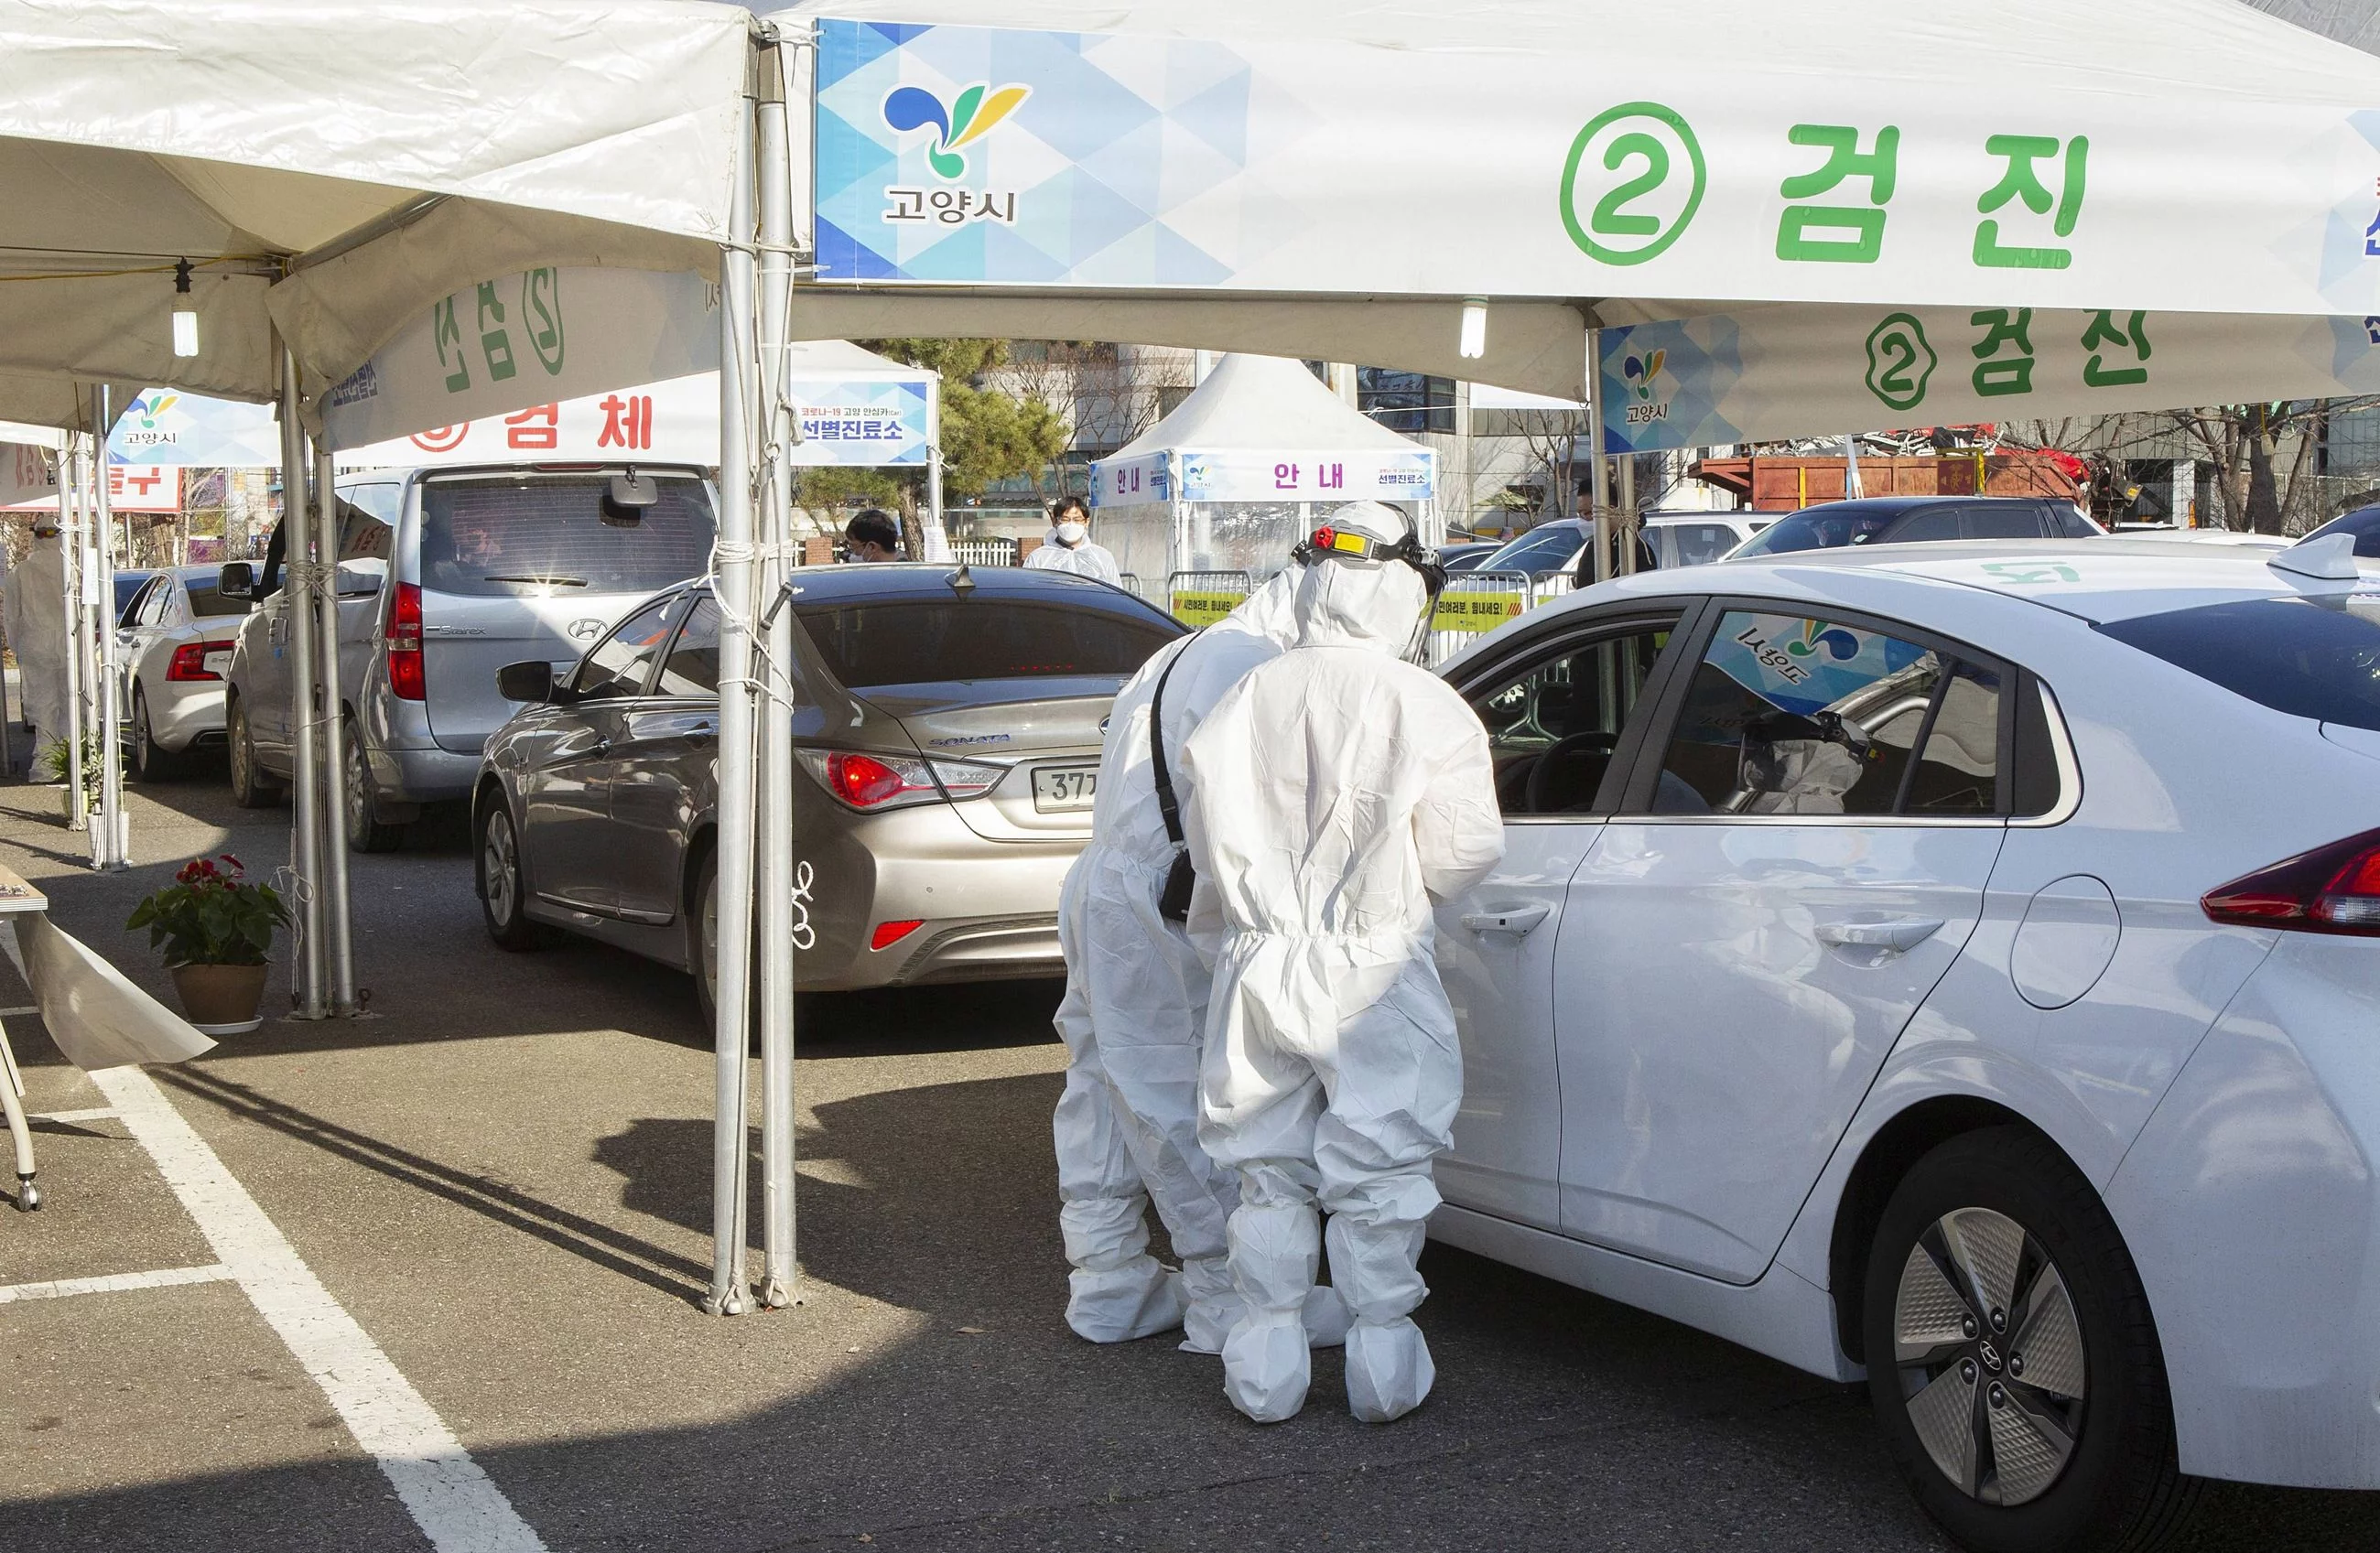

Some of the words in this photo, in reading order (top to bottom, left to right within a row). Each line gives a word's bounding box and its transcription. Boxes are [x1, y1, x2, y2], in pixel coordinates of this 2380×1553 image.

[884, 189, 1017, 225] 고양시
[801, 407, 841, 416] 코로나-19
[844, 407, 860, 416] 고양
[1626, 404, 1669, 424] 고양시
[804, 419, 903, 440] 선별진료소
[124, 432, 177, 445] 고양시
[1378, 474, 1426, 485] 선별진료소
[1471, 601, 1503, 616] 힘내세요!
[440, 625, 487, 635] Starex
[928, 733, 1012, 748] SONATA
